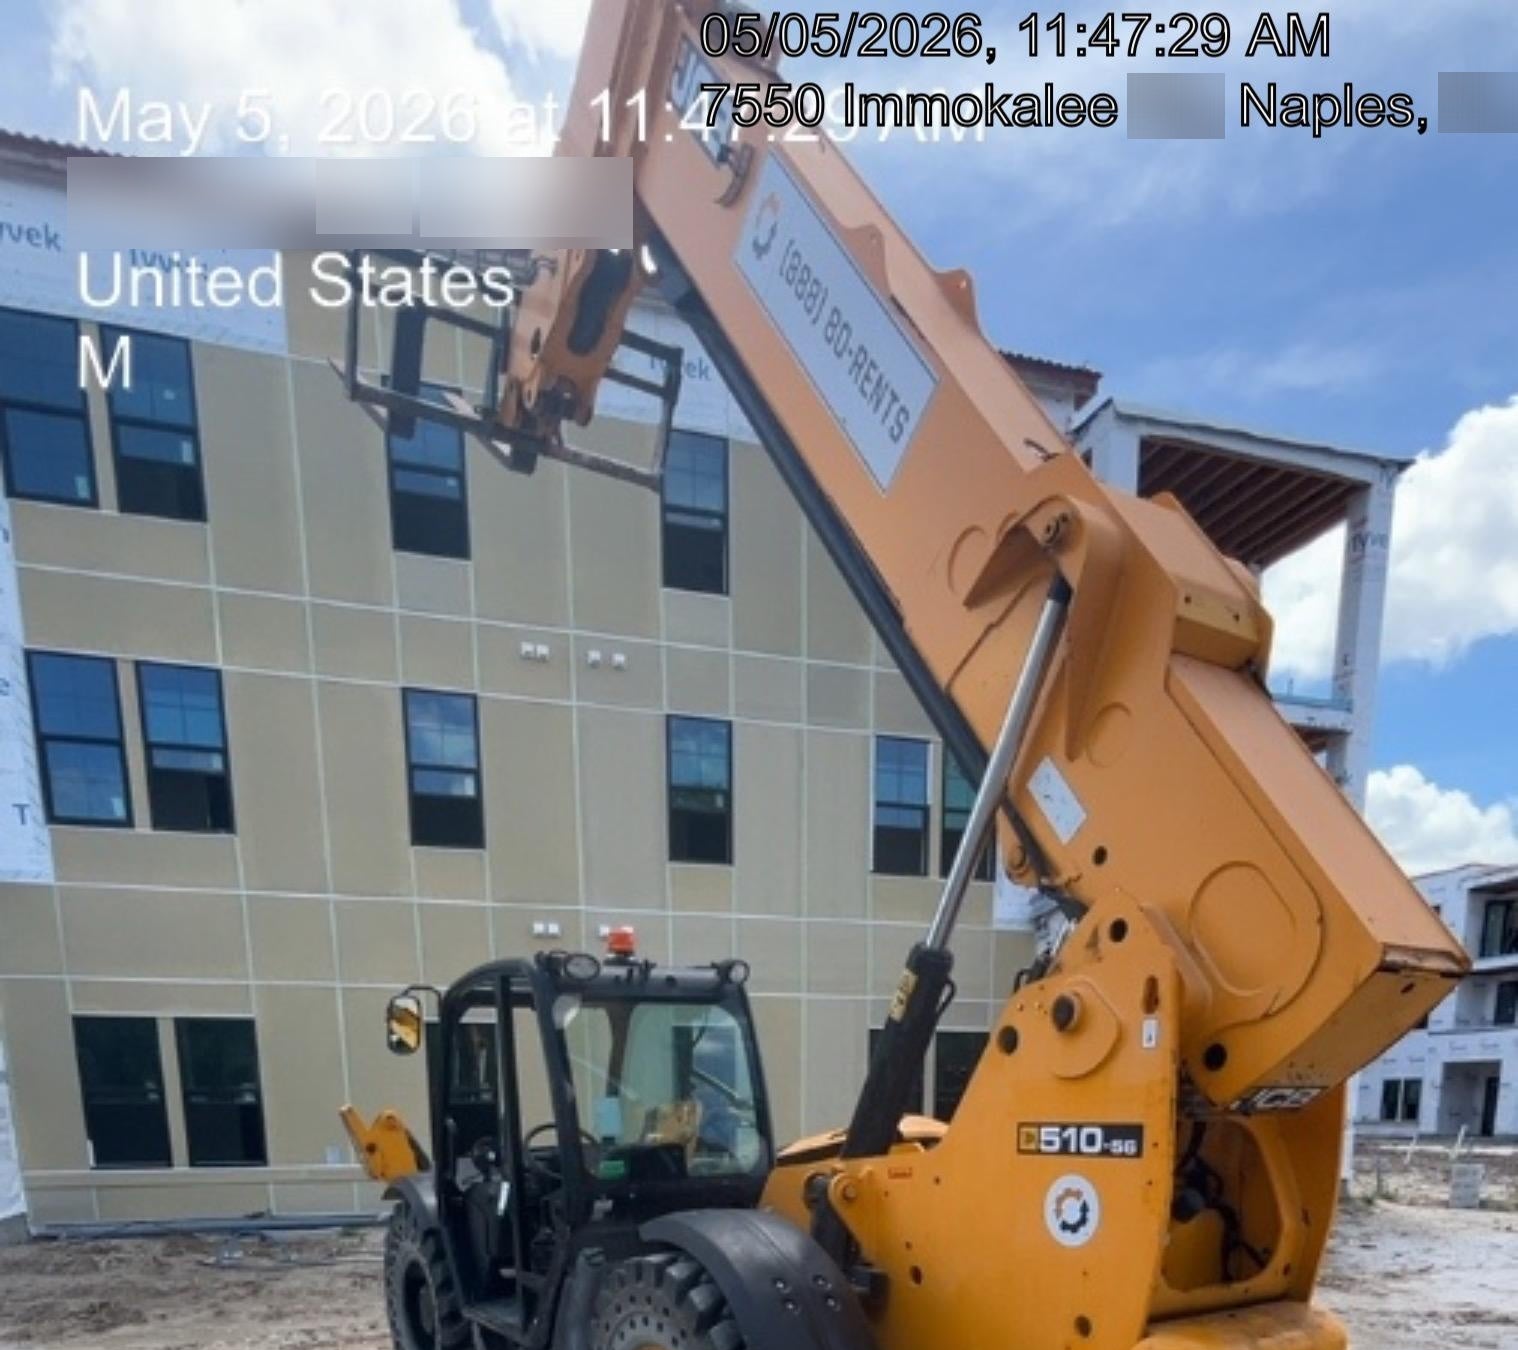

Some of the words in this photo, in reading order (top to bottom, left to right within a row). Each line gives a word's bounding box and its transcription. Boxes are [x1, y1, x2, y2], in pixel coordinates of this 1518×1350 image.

[779, 238, 829, 326] (888)
[823, 307, 910, 445] 80-RENTS
[1039, 1125, 1138, 1156] 510-56
